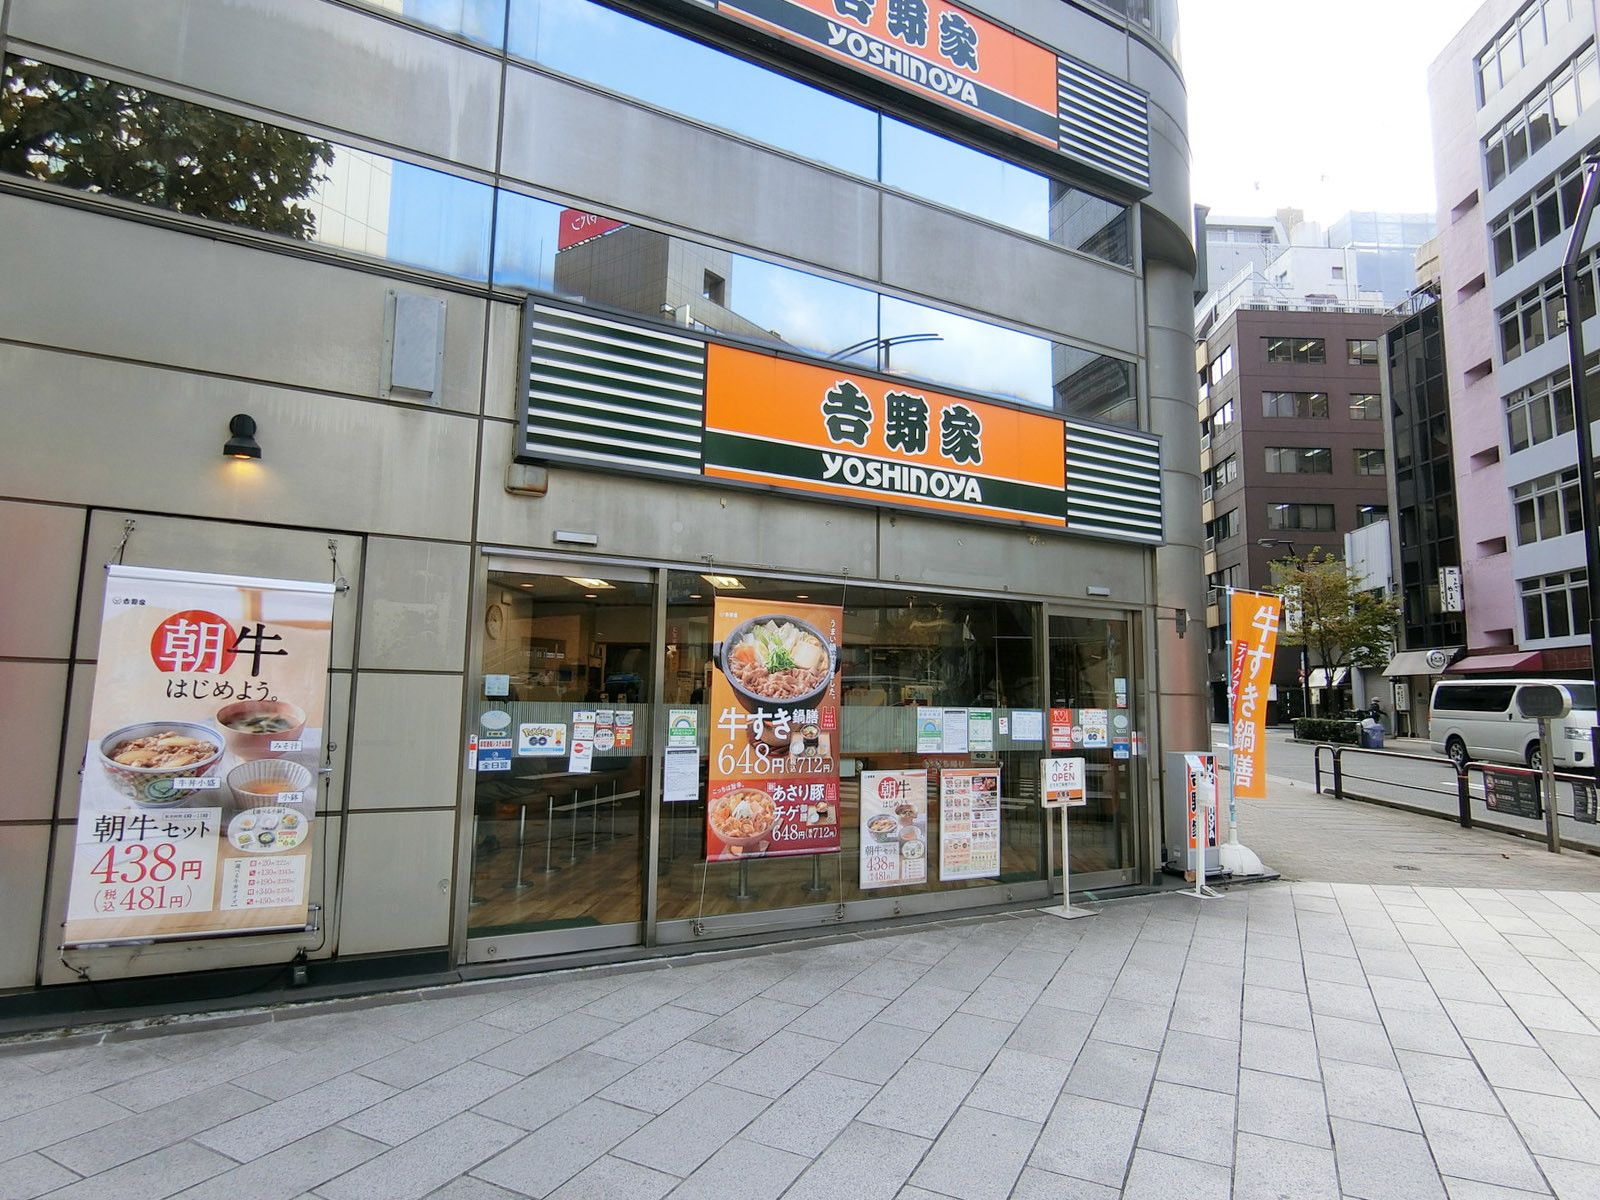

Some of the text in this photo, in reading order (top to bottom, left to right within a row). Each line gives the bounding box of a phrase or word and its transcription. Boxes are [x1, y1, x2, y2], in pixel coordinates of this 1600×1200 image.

[828, 22, 978, 106] YOSHINOYA
[821, 380, 983, 466] 吉野家
[822, 453, 982, 502] YOSHINOYA
[159, 618, 289, 677] 朝牛
[166, 679, 278, 702] はじめよう。
[1233, 605, 1279, 789] 牛すき鍋膳
[529, 737, 548, 746] GO
[1052, 771, 1075, 782] OPEN
[1062, 762, 1074, 771] 2F
[773, 784, 825, 802] あさり豚
[880, 779, 911, 799] 朝牛
[92, 814, 211, 843] 朝牛セット
[90, 843, 203, 884] 438円
